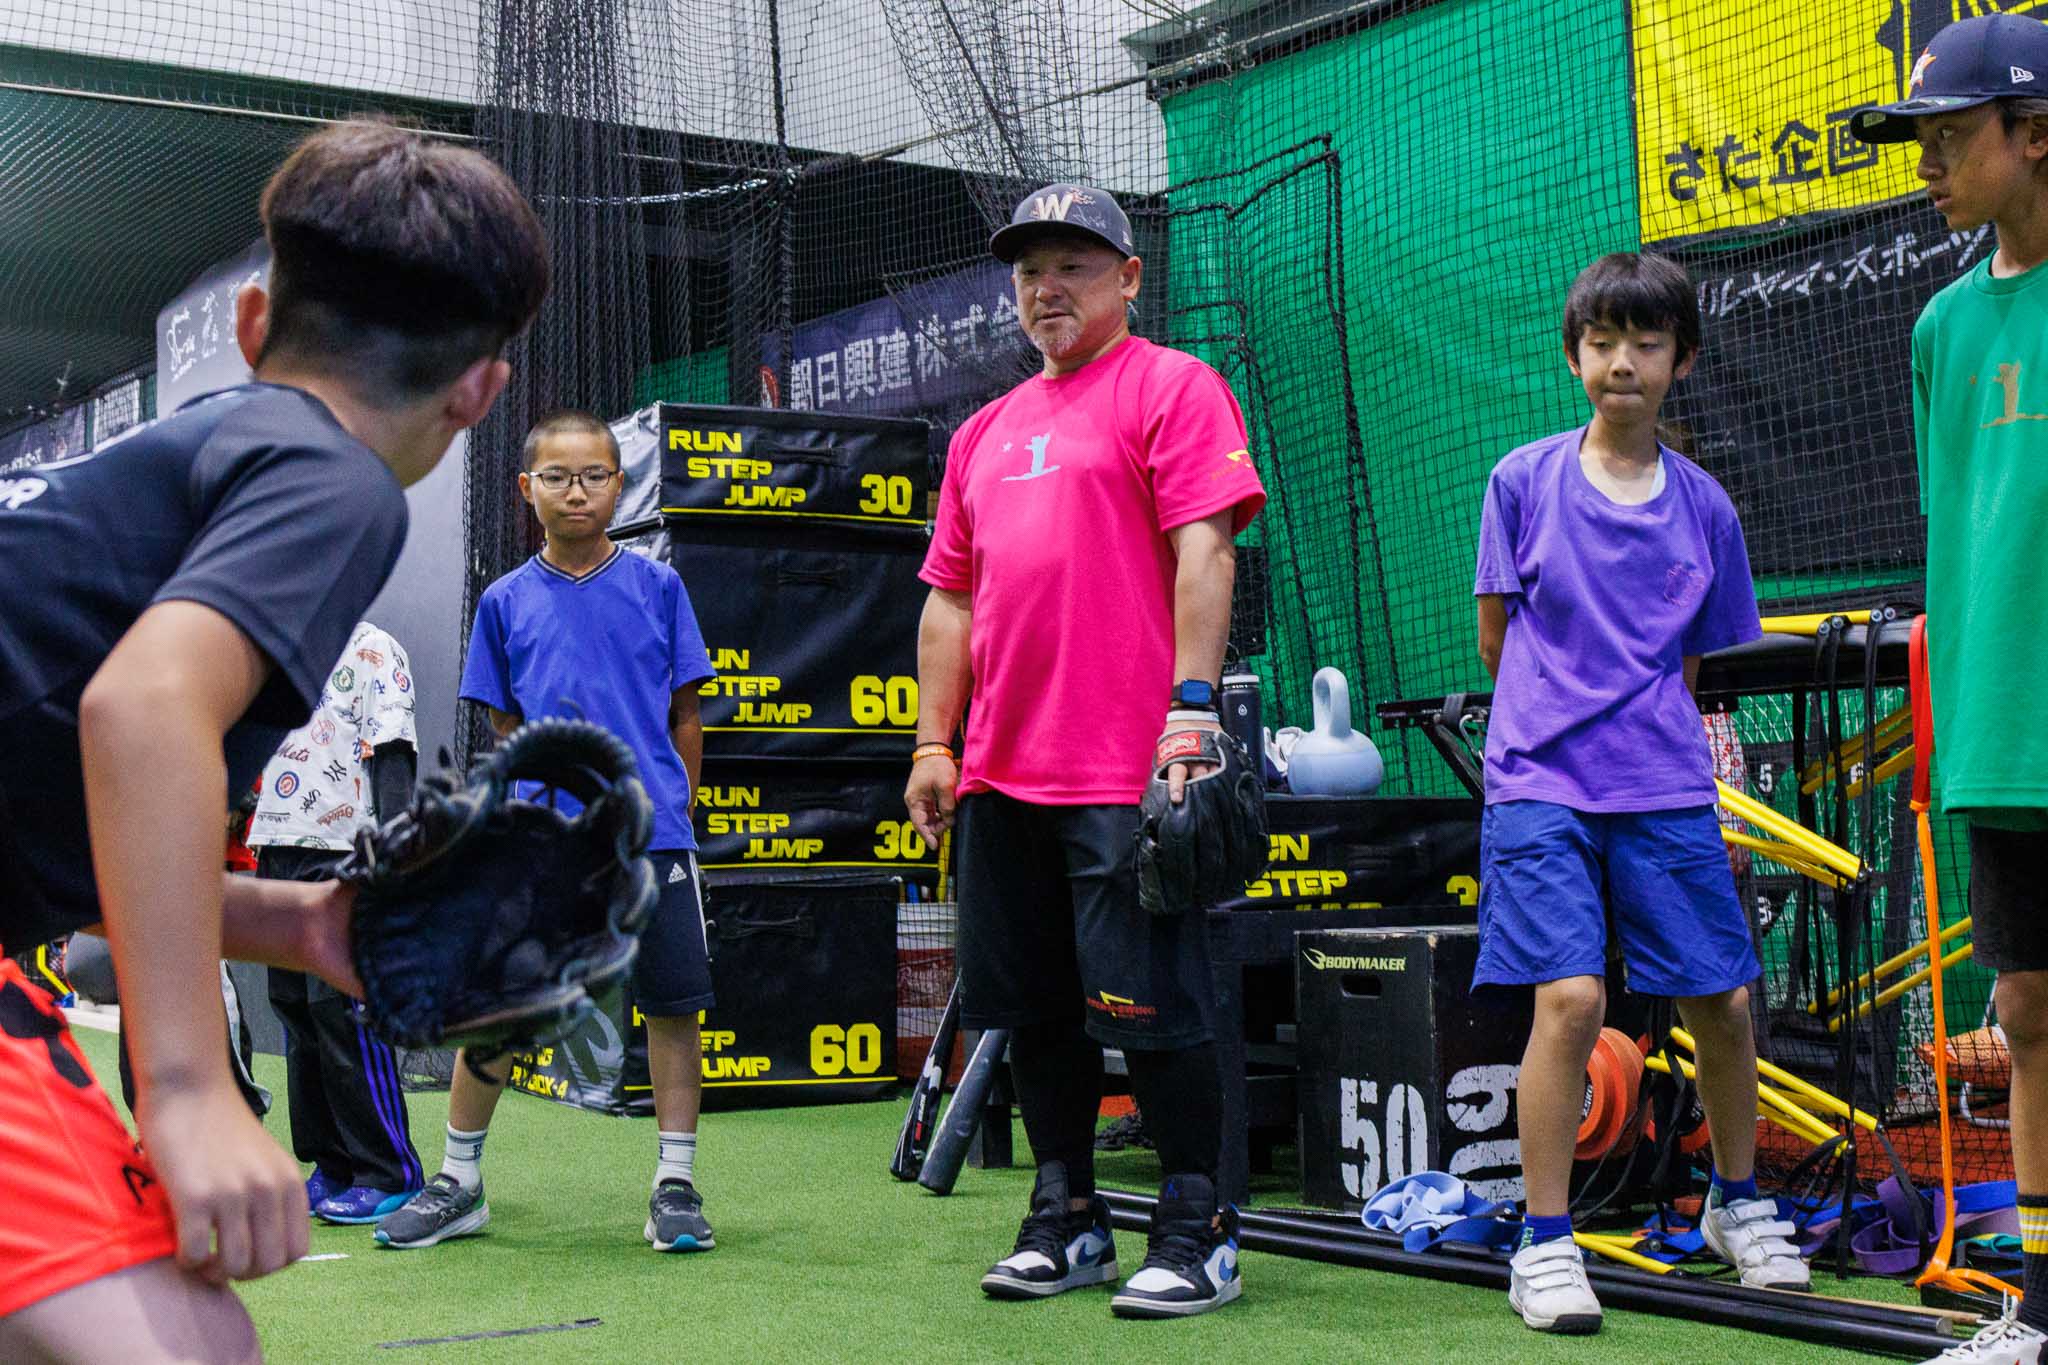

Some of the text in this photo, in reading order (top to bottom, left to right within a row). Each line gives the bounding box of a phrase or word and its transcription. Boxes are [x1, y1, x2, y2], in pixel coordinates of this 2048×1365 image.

[1665, 100, 1879, 202] さだ企画
[1036, 193, 1074, 221] W
[669, 430, 742, 453] RUN
[688, 458, 773, 479] STEP
[724, 474, 913, 515] JUMP 30
[705, 648, 750, 671] UN
[698, 676, 781, 697] STEP
[733, 675, 920, 726] JUMP 60
[1759, 763, 1773, 793] 5
[694, 786, 760, 808] RUN
[707, 813, 790, 834] STEP
[744, 820, 926, 859] JUMP 30
[1245, 870, 1348, 897] STEP
[1325, 956, 1407, 972] BODYMAKER
[701, 1023, 881, 1079] UMP 60
[1340, 1076, 1428, 1200] 50
